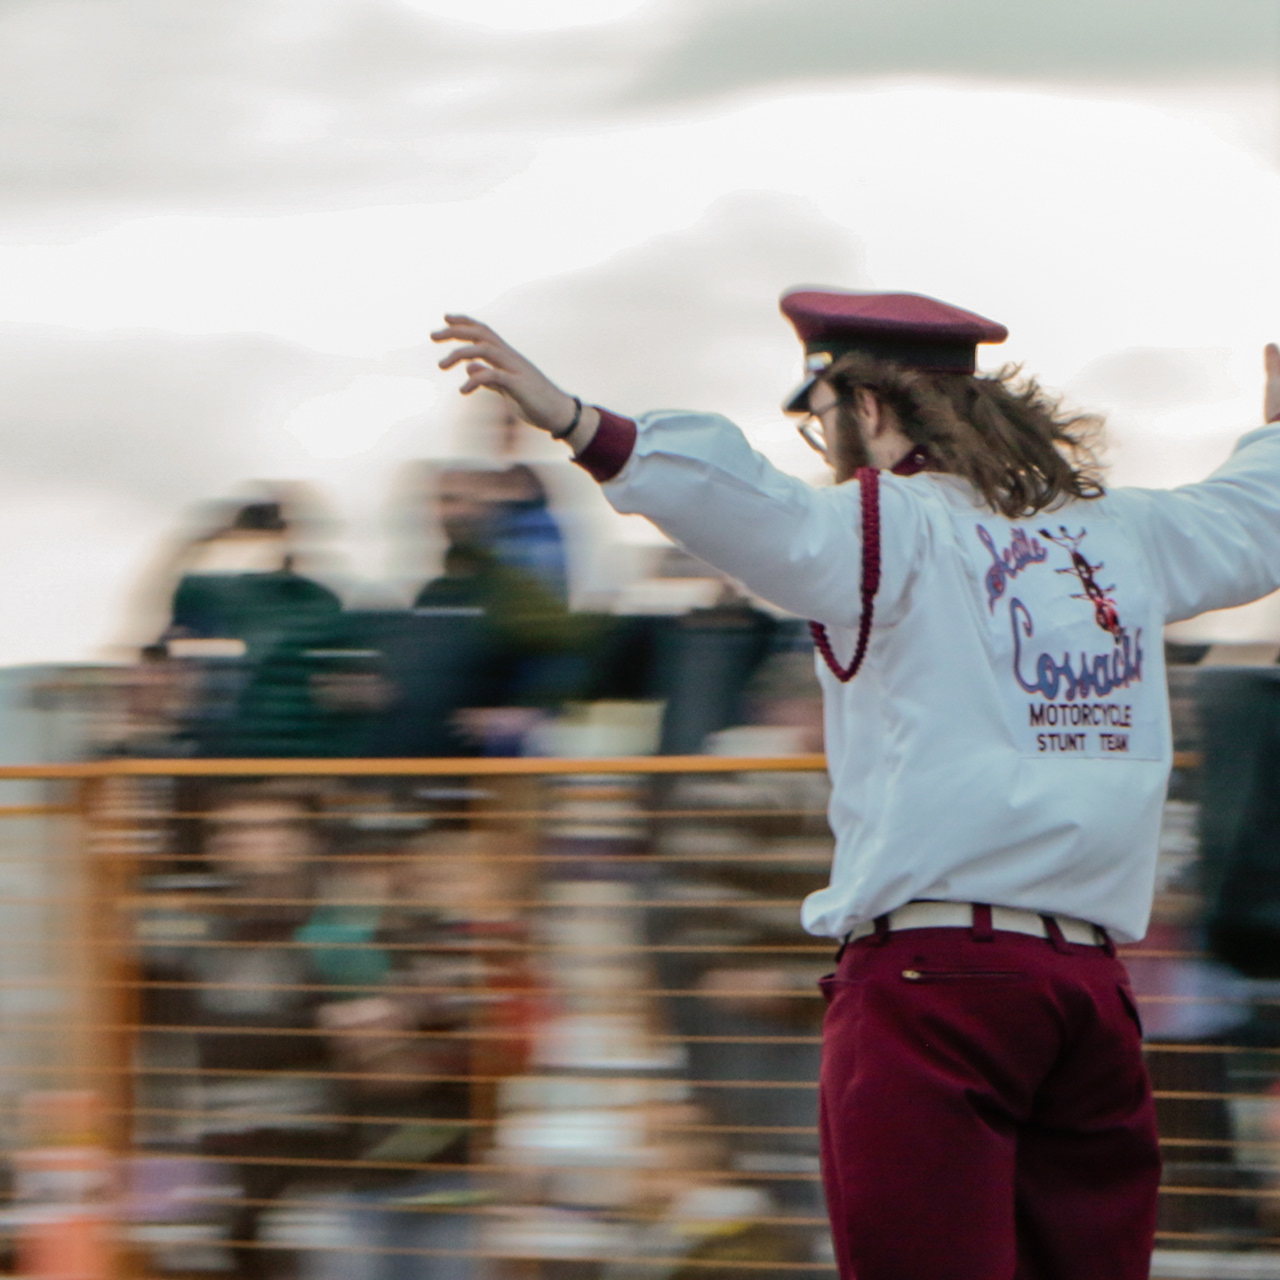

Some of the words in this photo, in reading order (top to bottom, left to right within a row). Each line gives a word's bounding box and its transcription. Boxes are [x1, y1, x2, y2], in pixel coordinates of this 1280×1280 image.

[1029, 703, 1132, 728] MOTORCYCLE
[1037, 733, 1086, 752] STUNT
[1099, 733, 1130, 752] TEAM
